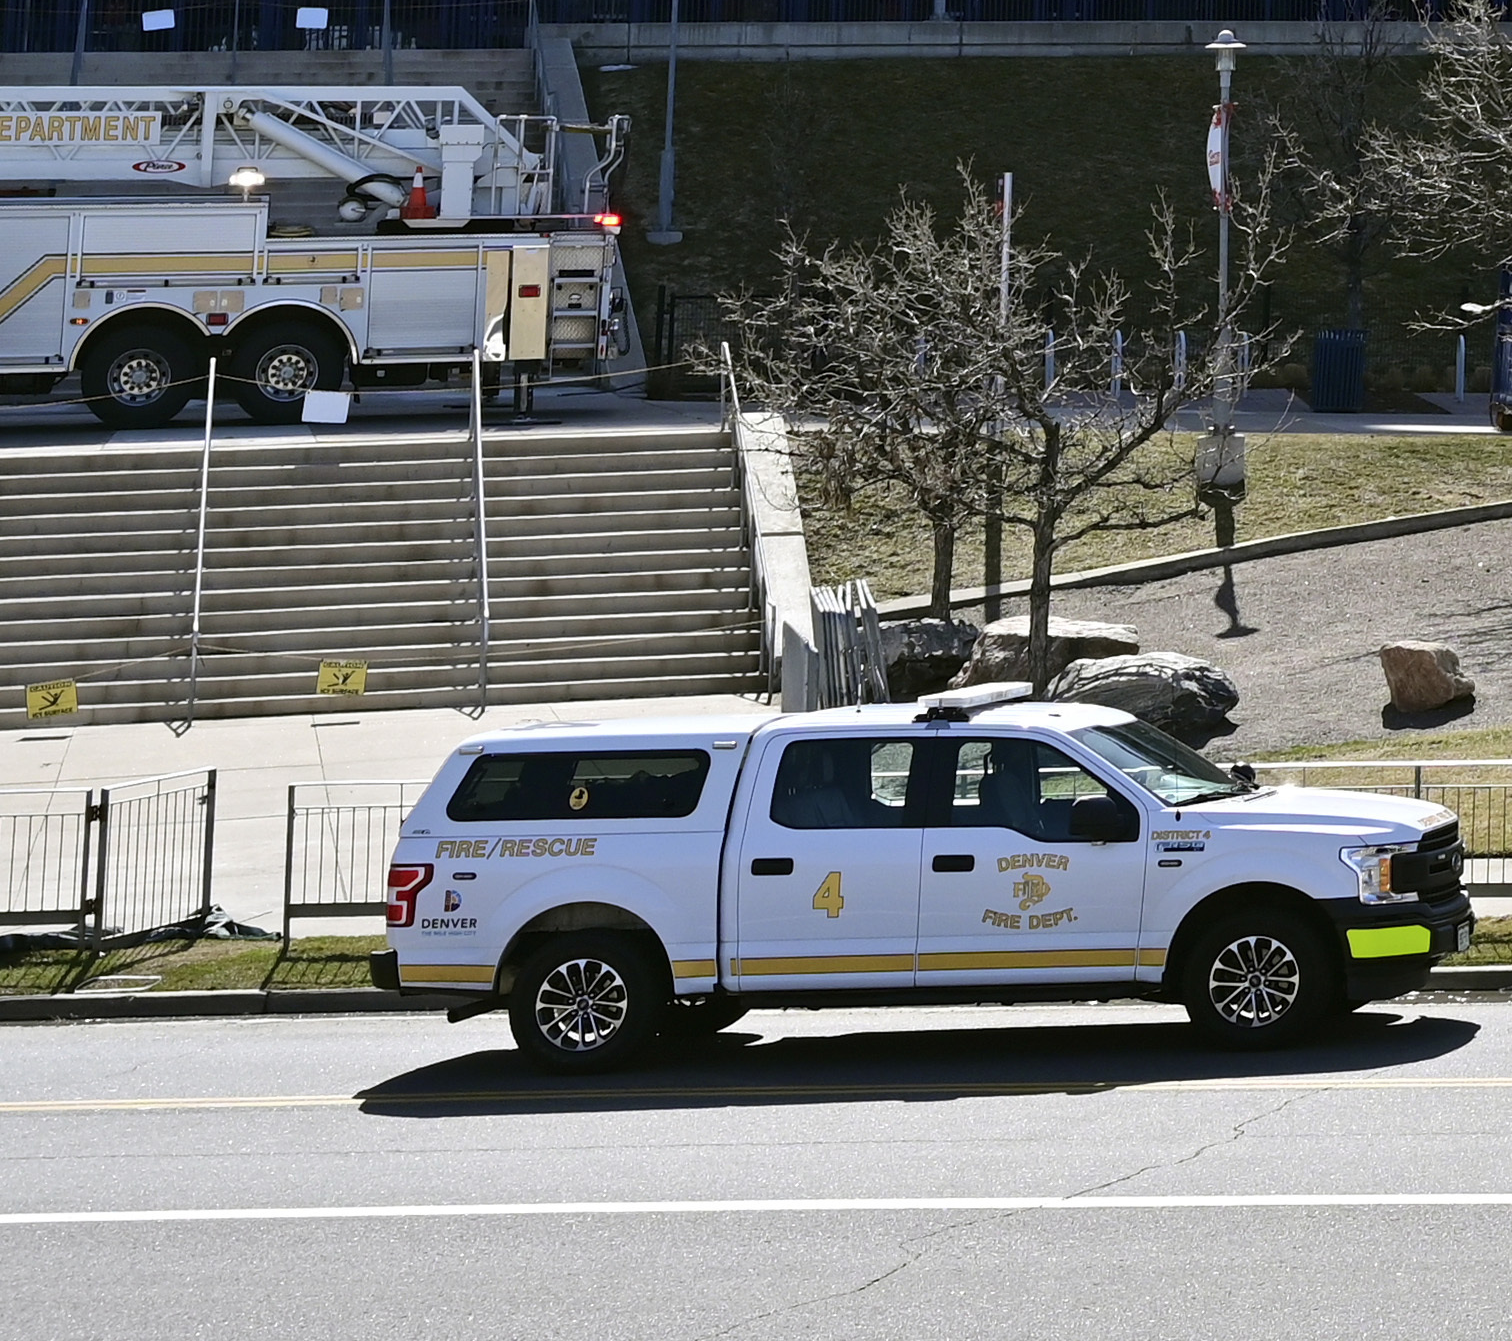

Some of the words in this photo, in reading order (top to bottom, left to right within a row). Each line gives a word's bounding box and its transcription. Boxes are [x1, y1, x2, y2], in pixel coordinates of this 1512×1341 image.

[29, 680, 73, 693] CAUTION
[1151, 830, 1200, 840] DISTRICT
[1203, 830, 1211, 839] 4
[435, 838, 598, 860] FIRE/RESCUE
[997, 853, 1070, 873] DENVER
[812, 871, 844, 918] 4
[421, 918, 477, 929] DENVER
[981, 909, 1021, 930] FIRE
[1028, 907, 1078, 930] DEPT.
